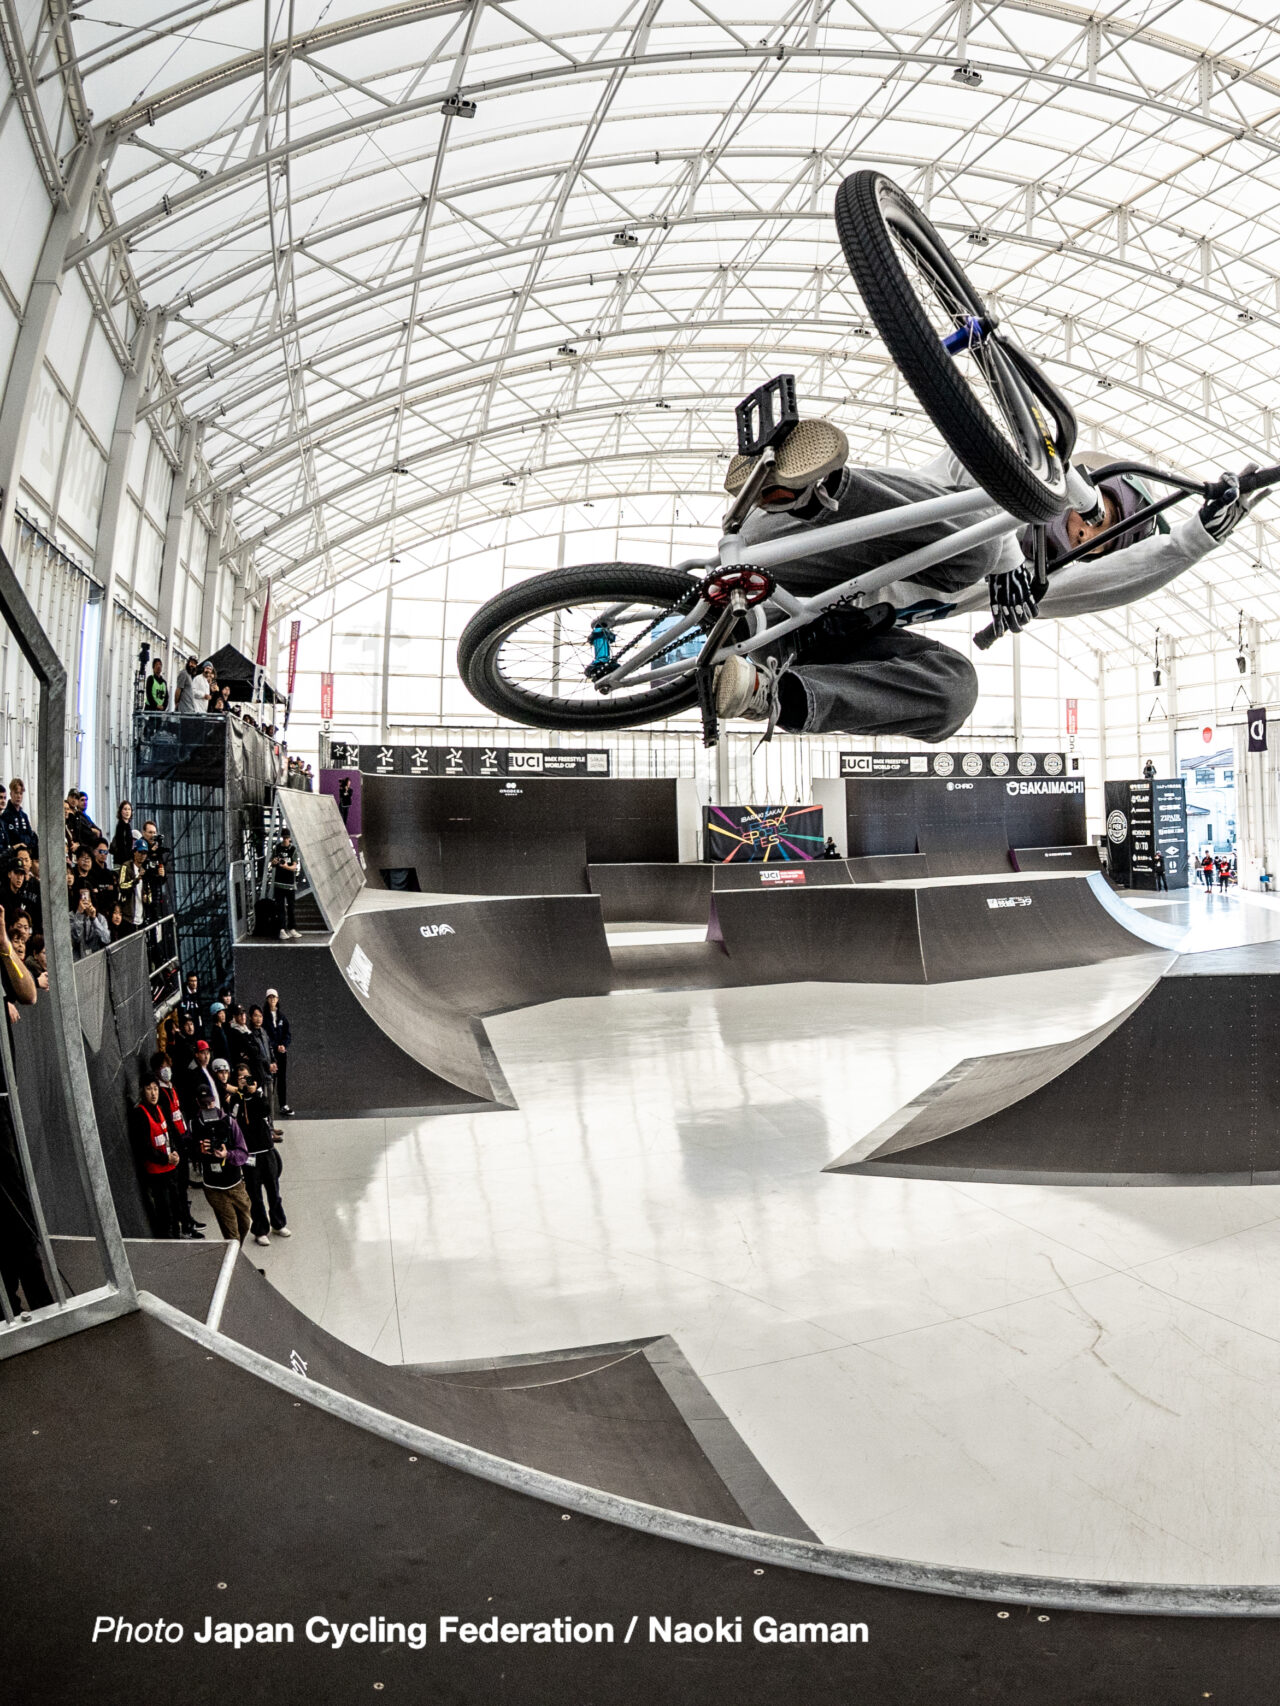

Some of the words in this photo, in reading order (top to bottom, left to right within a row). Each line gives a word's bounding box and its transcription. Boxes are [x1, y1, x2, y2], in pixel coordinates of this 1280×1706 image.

[514, 756, 540, 768] UCI
[847, 759, 870, 769] UCI
[1019, 781, 1084, 795] SAKAIMACHI
